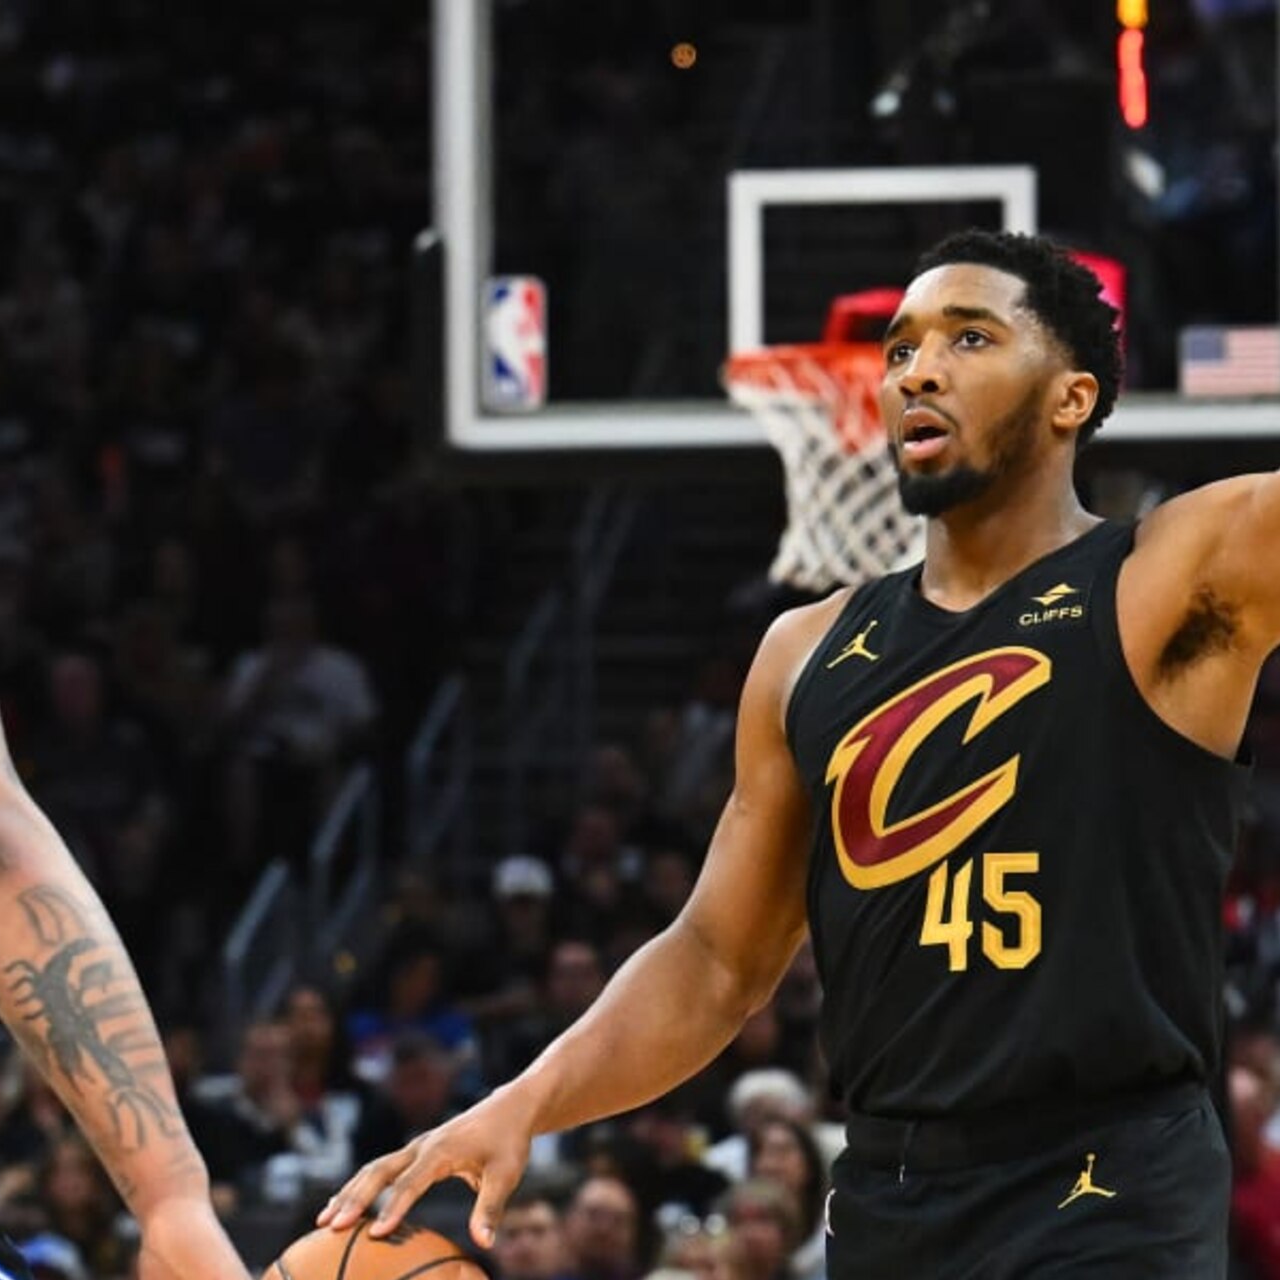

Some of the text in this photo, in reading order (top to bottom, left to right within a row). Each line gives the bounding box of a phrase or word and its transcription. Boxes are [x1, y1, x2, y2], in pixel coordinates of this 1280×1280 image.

[1019, 605, 1083, 626] CLIFFS
[825, 646, 1052, 890] C
[919, 852, 1042, 972] 45
